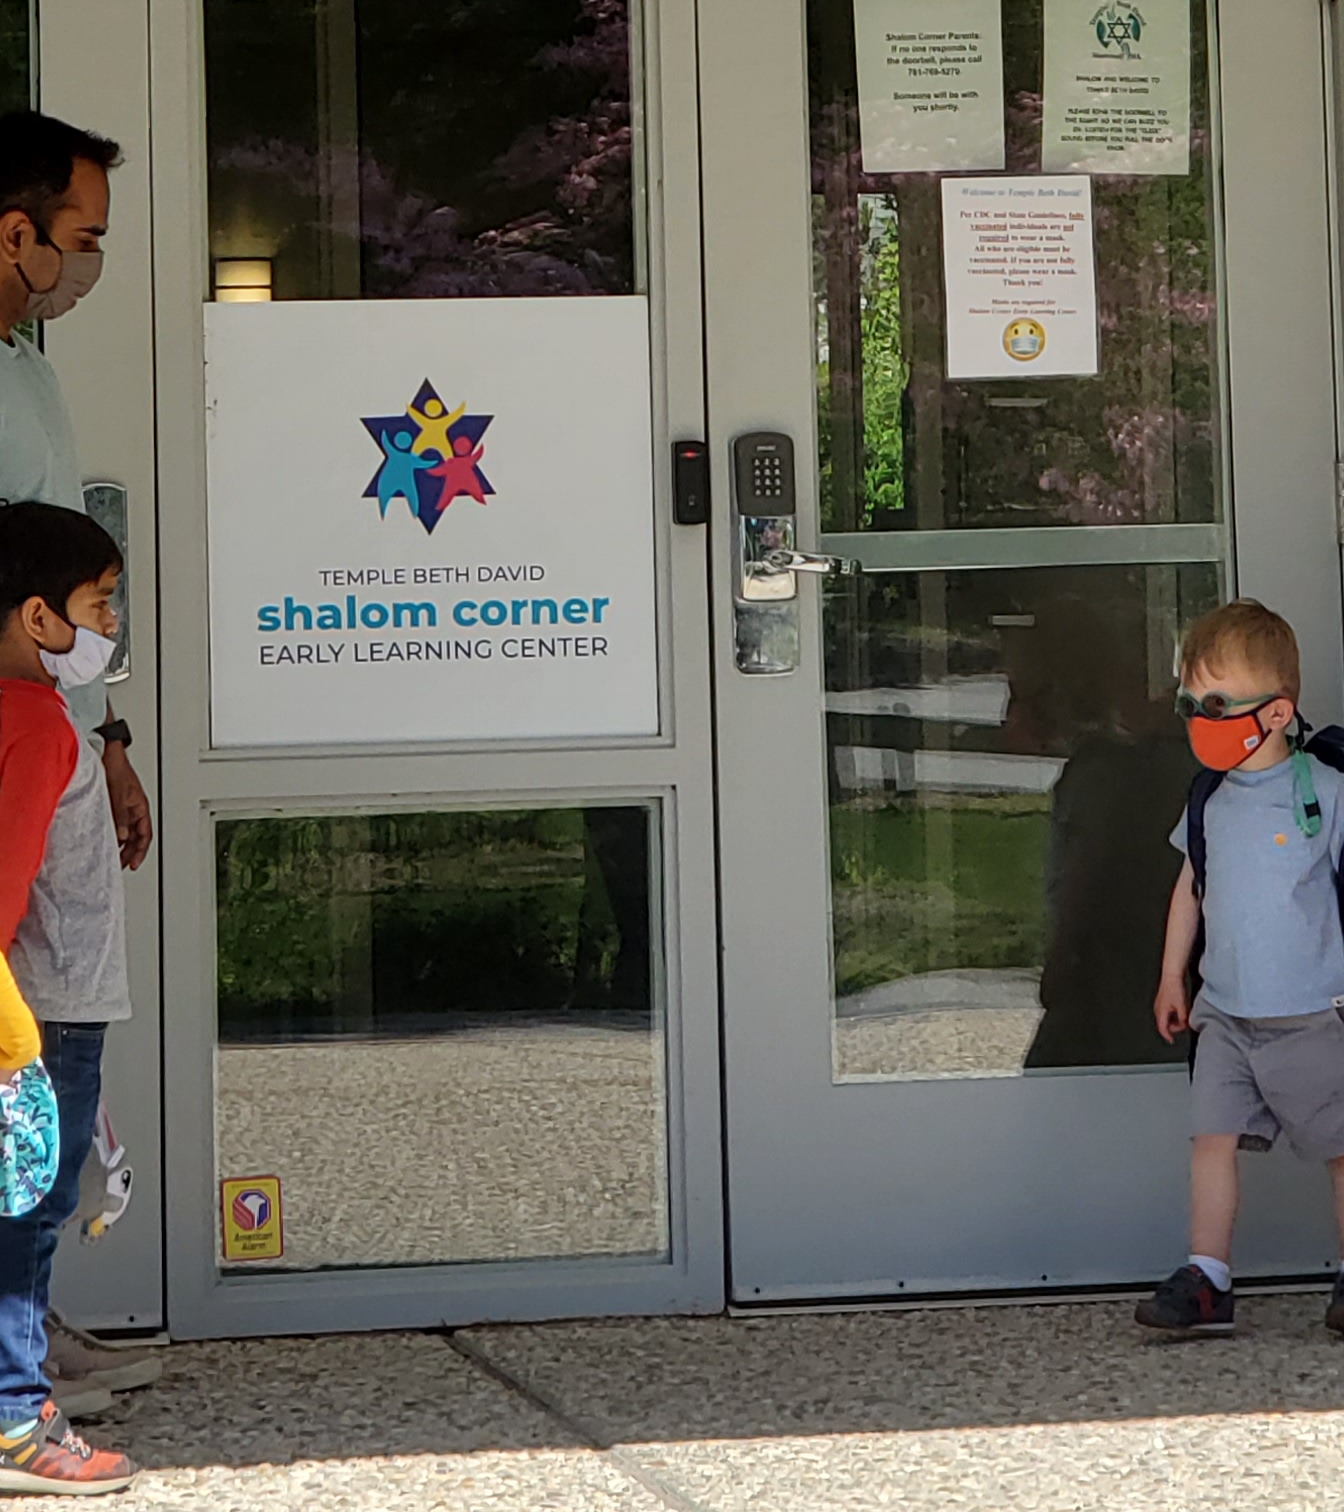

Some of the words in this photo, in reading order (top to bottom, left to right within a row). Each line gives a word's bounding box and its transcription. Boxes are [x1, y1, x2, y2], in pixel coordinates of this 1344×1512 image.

[929, 45, 967, 53] responds
[887, 57, 900, 65] the
[940, 56, 966, 65] please
[968, 55, 982, 63] call
[913, 105, 928, 113] you
[319, 568, 406, 587] TEMPLE
[413, 567, 470, 585] BETH
[478, 565, 545, 583] DAVID
[257, 595, 438, 632] shalom
[452, 597, 610, 628] corner
[260, 643, 345, 666] EARLY
[354, 639, 492, 663] LEARNING
[502, 637, 608, 659] CENTER
